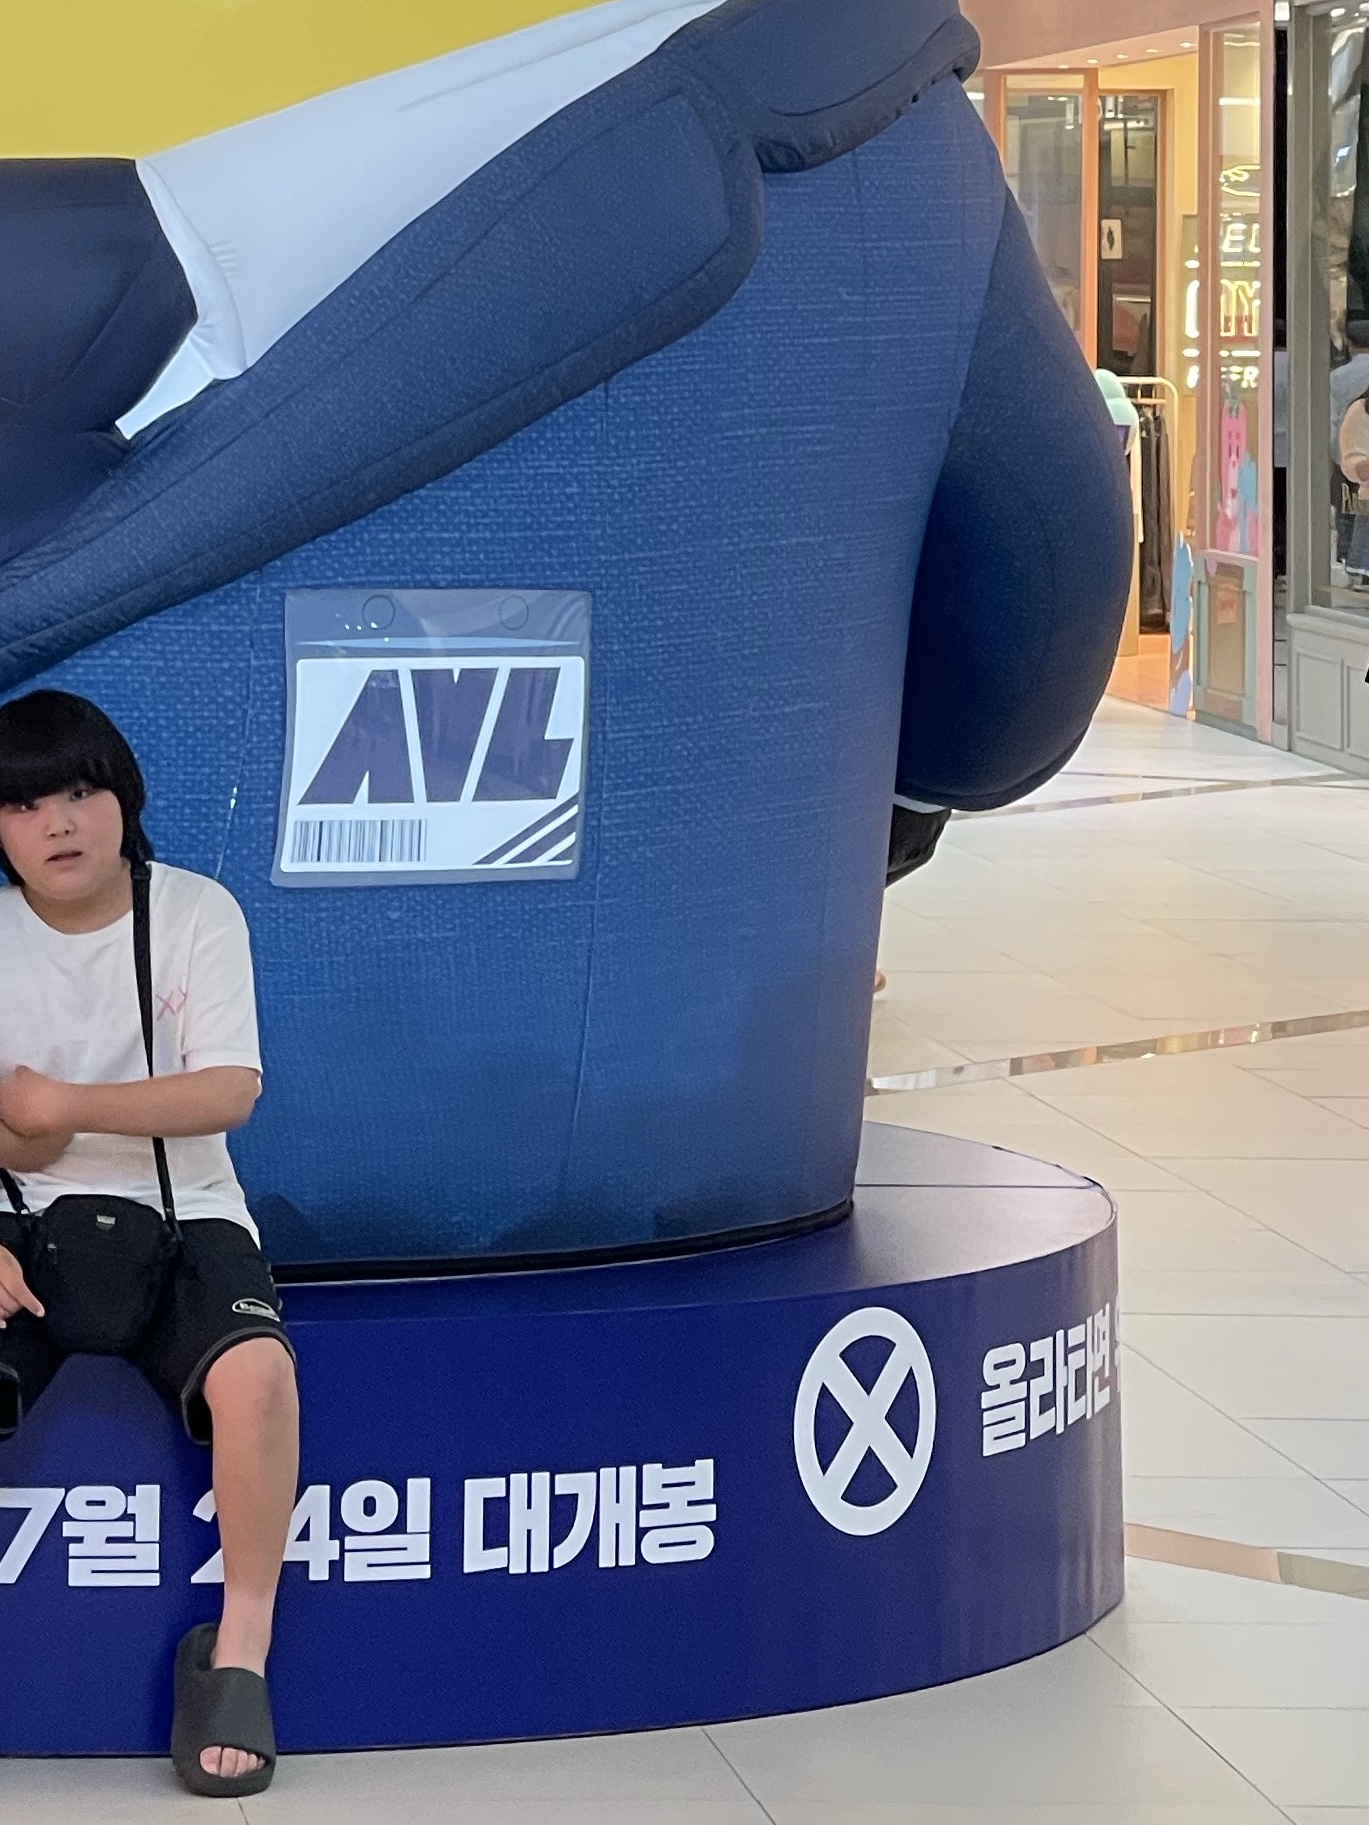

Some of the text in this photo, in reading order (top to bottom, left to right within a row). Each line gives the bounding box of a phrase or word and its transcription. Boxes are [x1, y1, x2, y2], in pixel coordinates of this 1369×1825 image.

[297, 666, 575, 805] AVL
[981, 1302, 1111, 1457] 올라타면
[463, 1458, 717, 1574] 대개봉
